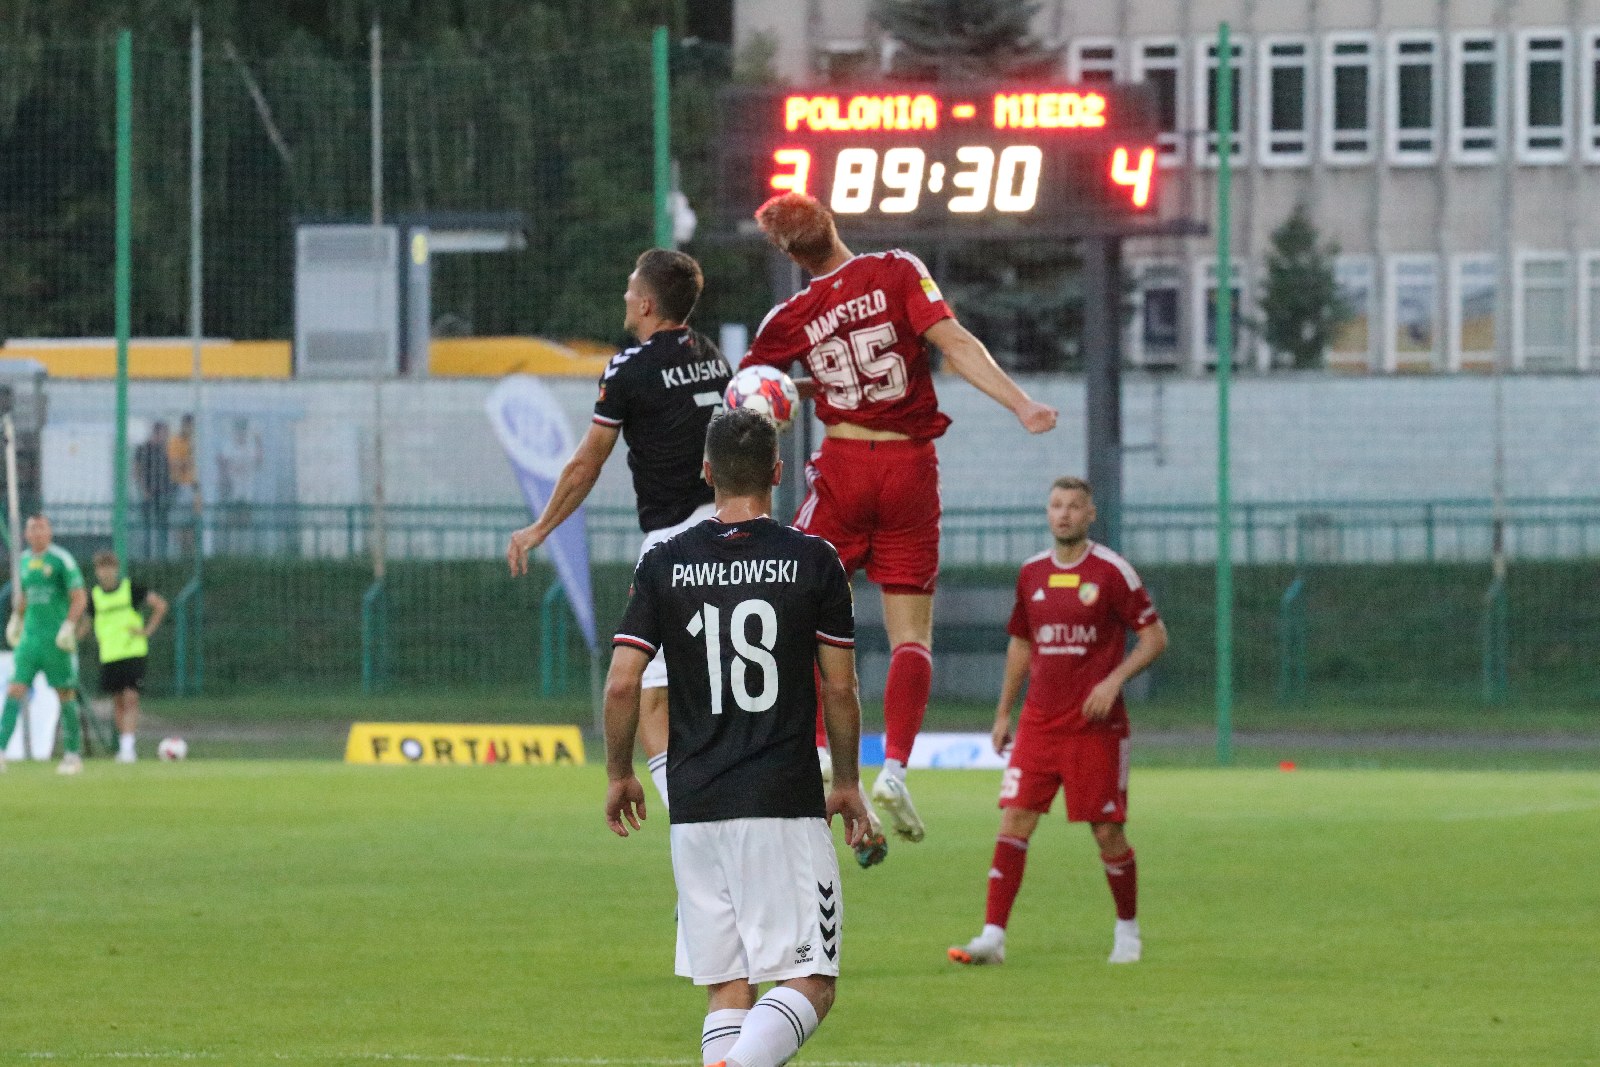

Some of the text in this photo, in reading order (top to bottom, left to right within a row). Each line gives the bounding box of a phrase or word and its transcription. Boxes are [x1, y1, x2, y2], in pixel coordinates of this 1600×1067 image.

[785, 95, 937, 131] POLONIA
[770, 148, 811, 195] 3
[830, 145, 1042, 213] 89:30
[1110, 146, 1155, 208] 4
[804, 289, 887, 345] MANSFELD
[661, 359, 729, 388] KLUSKA
[807, 321, 908, 410] 95
[672, 560, 798, 587] PAWŁOWSKI
[686, 599, 778, 714] 18
[369, 736, 576, 764] FORTUNA
